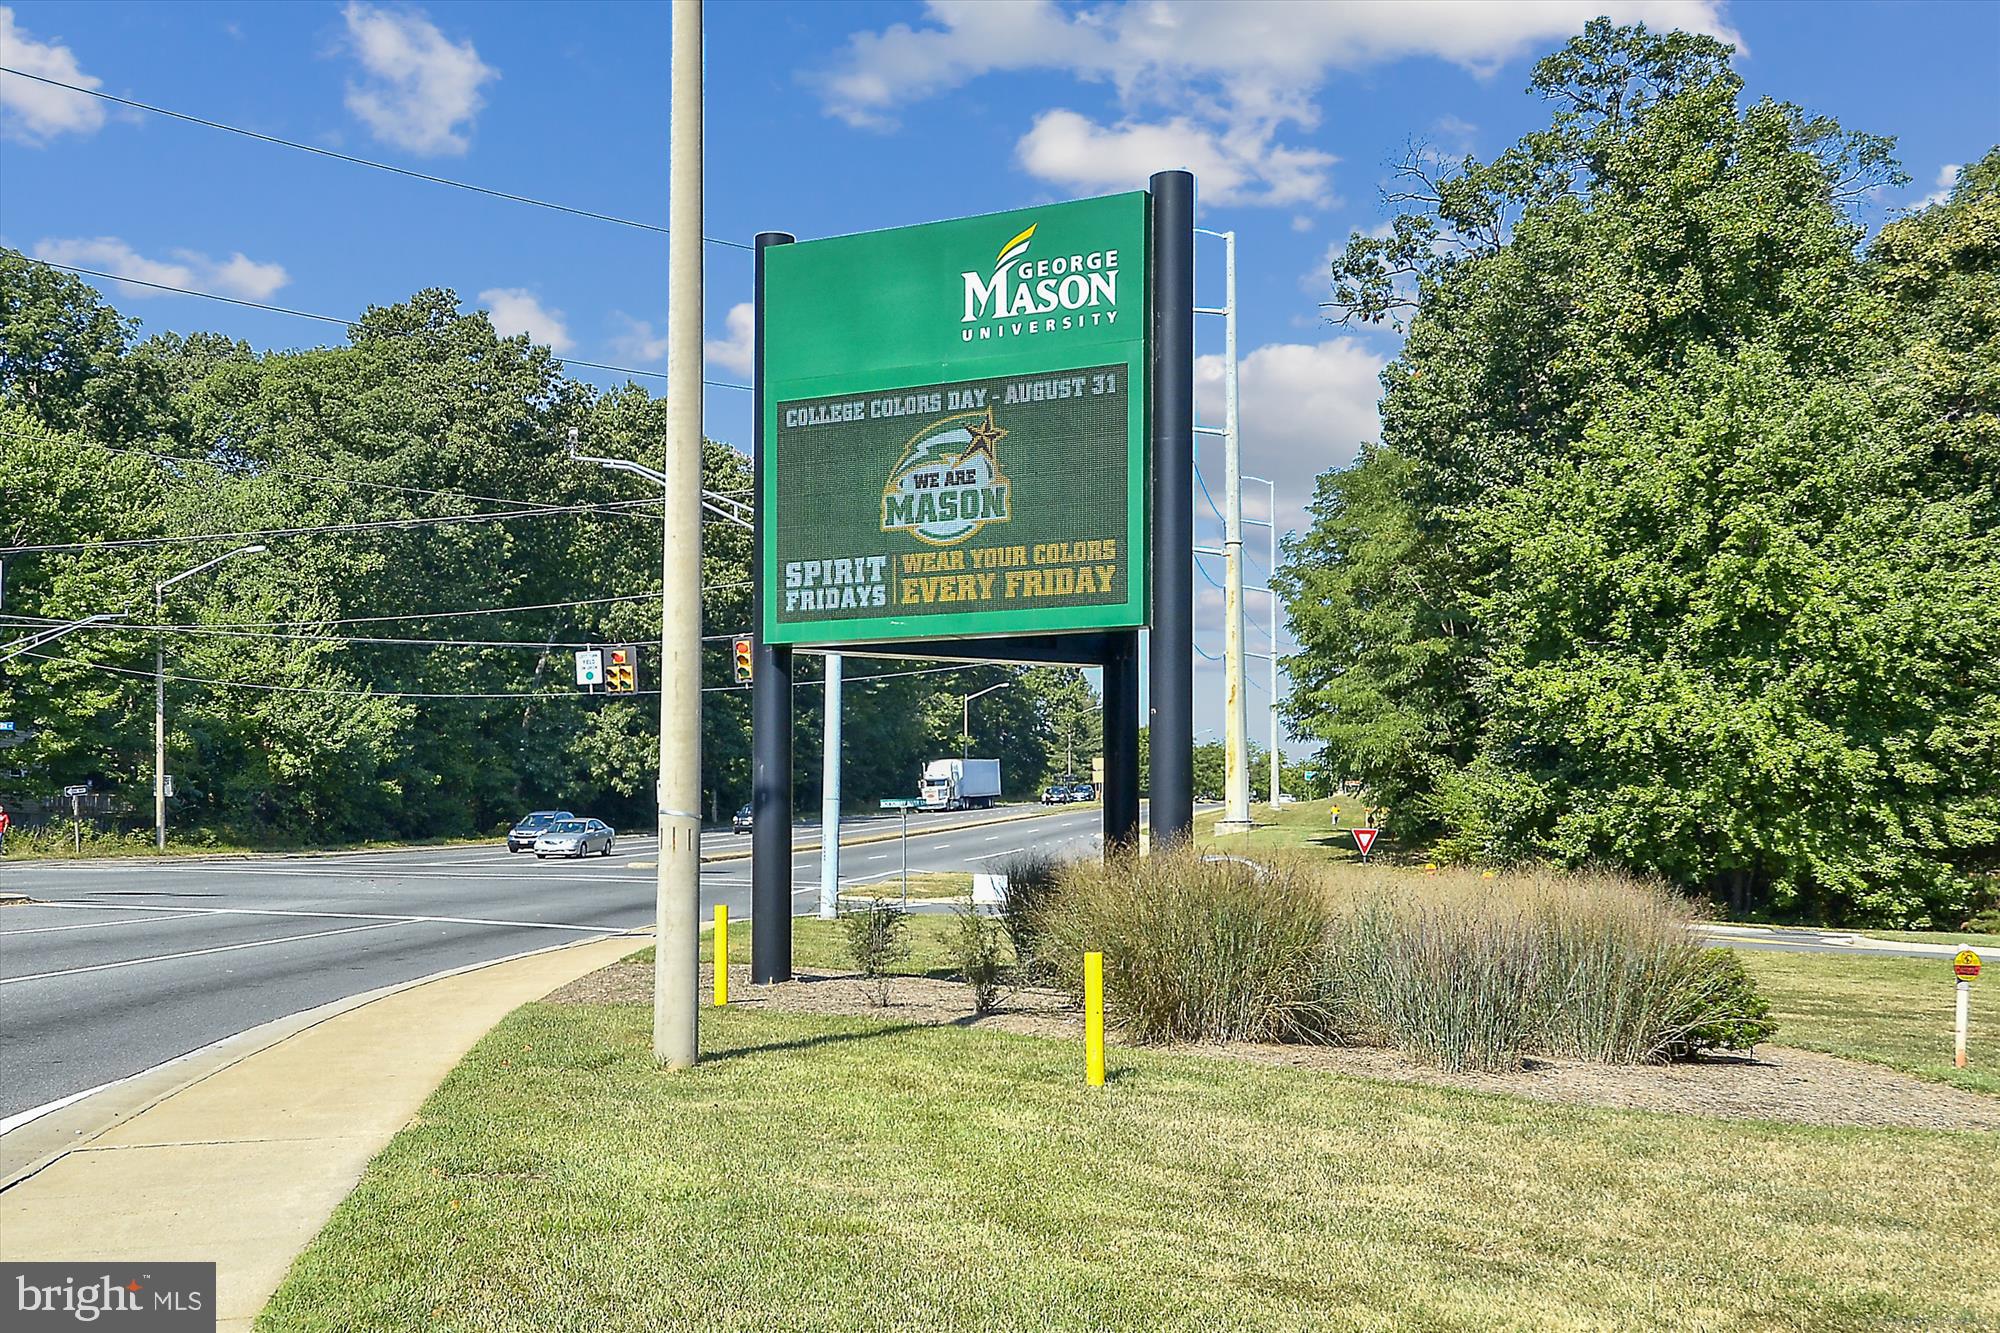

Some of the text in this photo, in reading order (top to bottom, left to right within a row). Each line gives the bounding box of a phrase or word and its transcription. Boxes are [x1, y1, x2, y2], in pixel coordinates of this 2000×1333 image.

[1018, 249, 1119, 280] GEORGE
[960, 258, 1119, 323] MASON
[961, 311, 1118, 342] UNIVERSITY
[786, 401, 865, 427] COLLEGE
[870, 393, 942, 419] COLORS
[947, 388, 988, 411] DAY
[1004, 376, 1086, 405] AUGUST
[1091, 373, 1116, 395] 31
[914, 468, 977, 489] WE ARE
[885, 486, 1007, 526] MASON
[785, 555, 886, 588] SPIRIT
[901, 538, 1116, 574] WEAR YOUR COLORS
[785, 584, 886, 612] FRIDAYS
[901, 564, 1116, 605] EVERY FRIDAY
